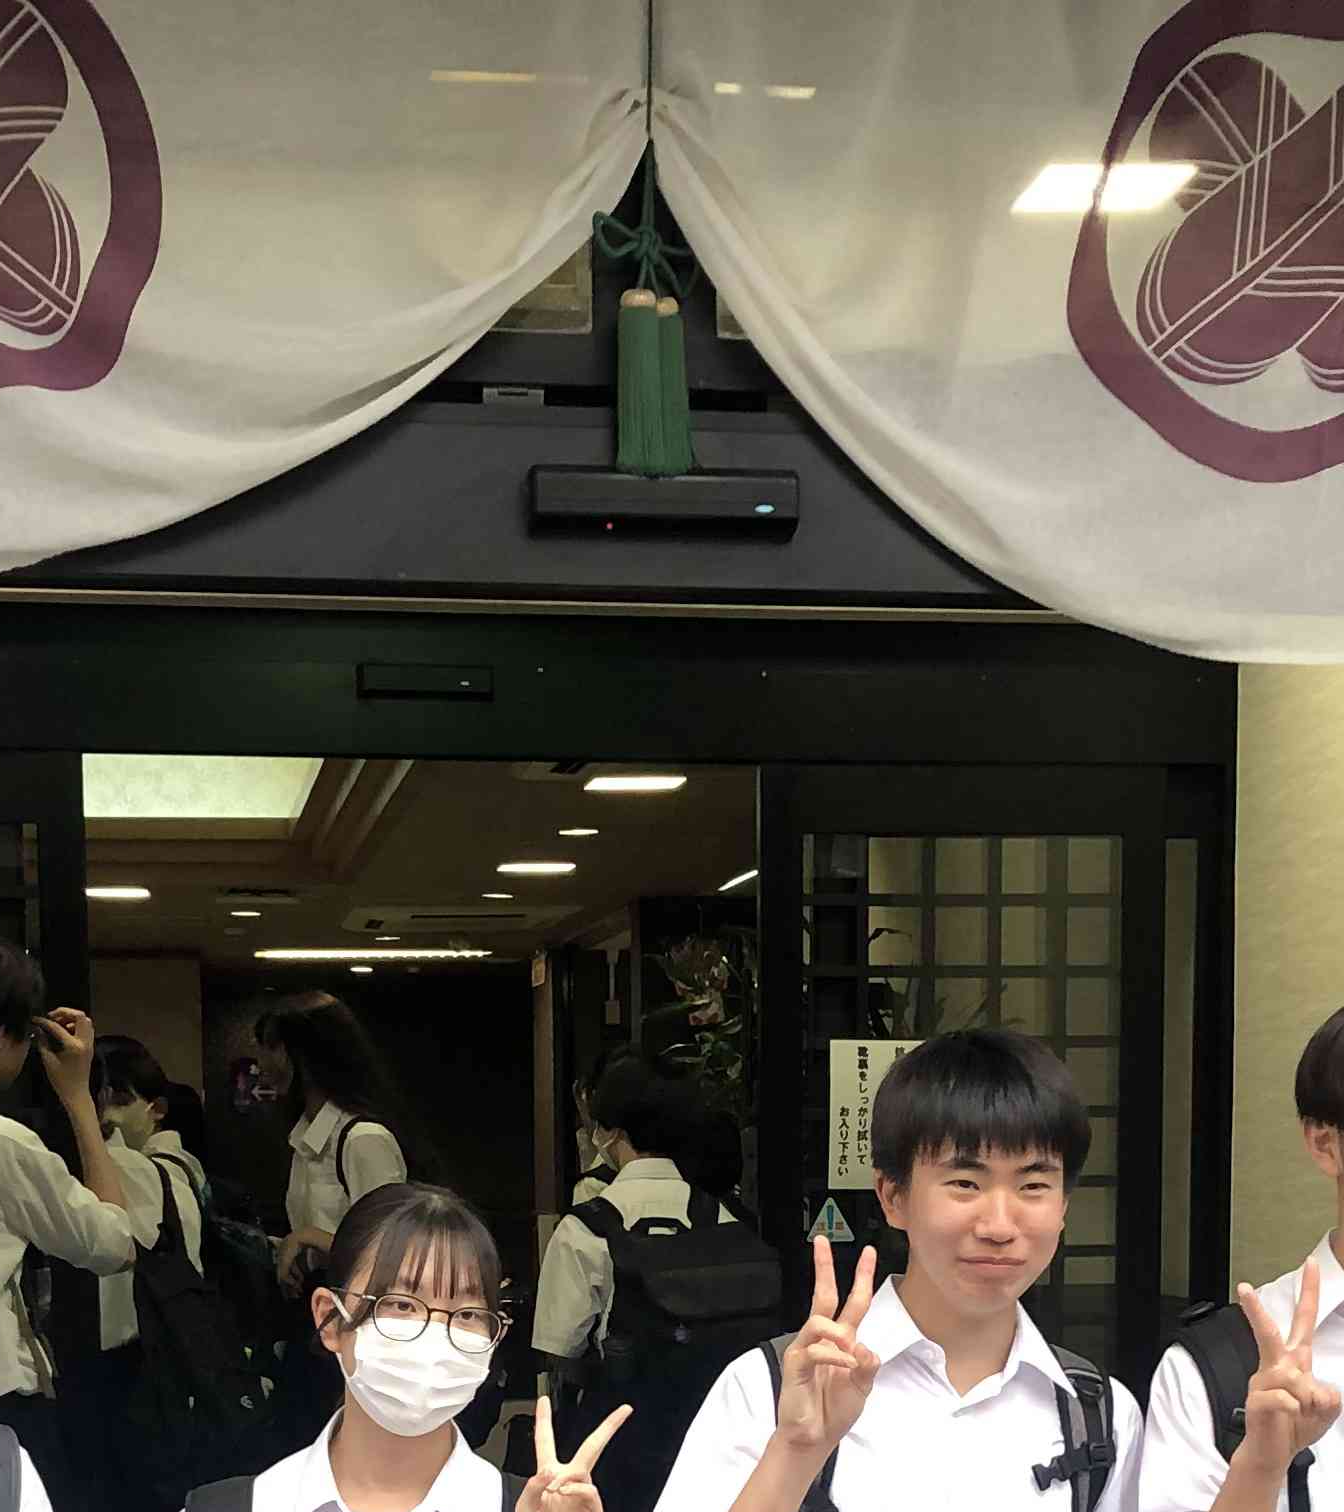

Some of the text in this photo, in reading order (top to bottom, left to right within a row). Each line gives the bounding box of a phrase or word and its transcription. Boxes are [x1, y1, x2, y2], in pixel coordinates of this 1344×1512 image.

[837, 1106, 850, 1176] お入り下さい
